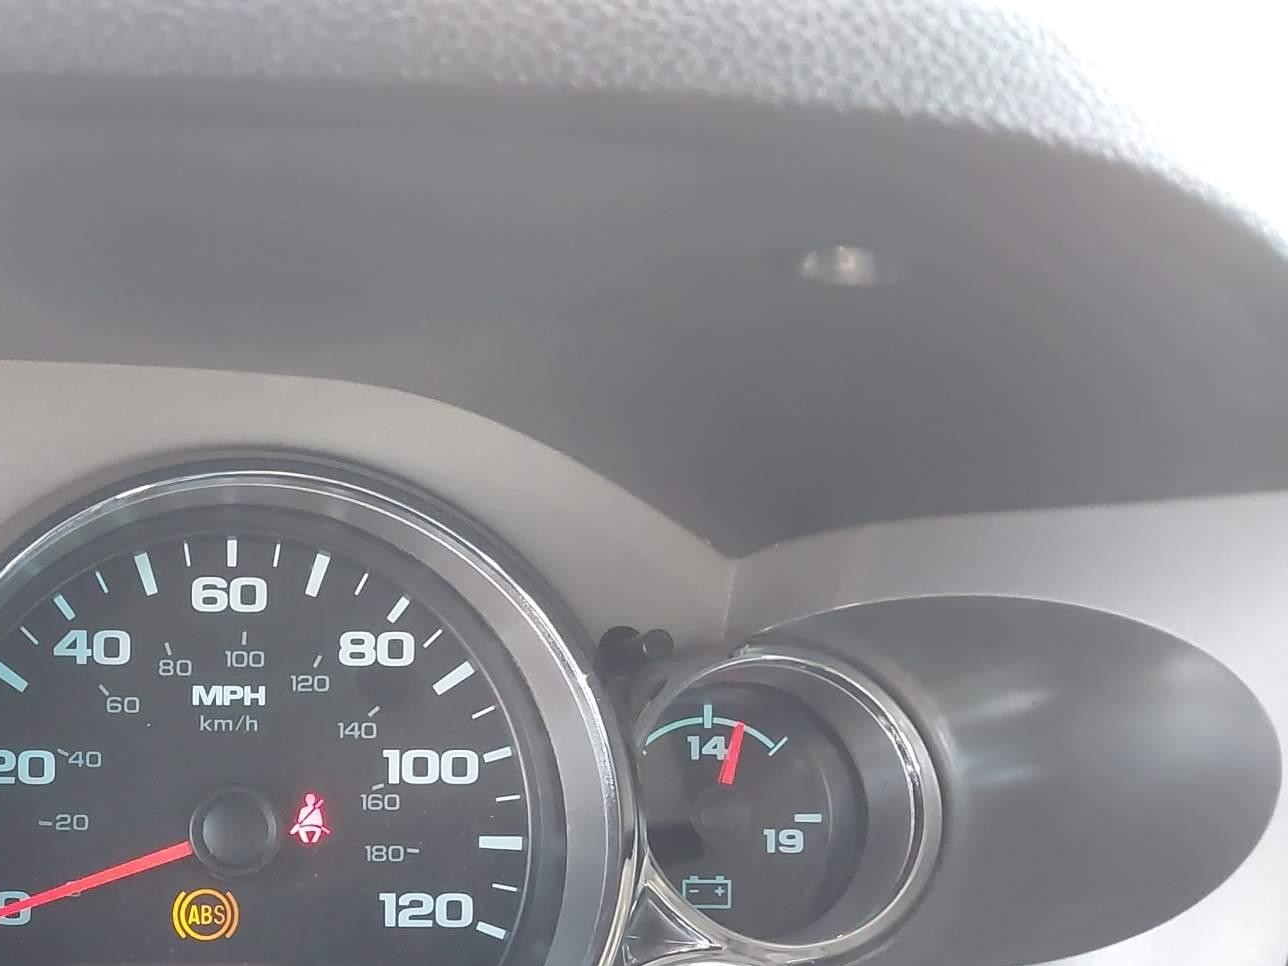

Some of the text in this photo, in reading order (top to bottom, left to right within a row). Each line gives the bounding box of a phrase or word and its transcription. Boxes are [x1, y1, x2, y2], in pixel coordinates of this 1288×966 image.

[191, 576, 268, 613] 60
[53, 629, 131, 666] 40
[338, 631, 415, 667] 80
[158, 659, 193, 677] 80
[224, 650, 265, 668] 100
[290, 675, 330, 692] 120
[192, 685, 266, 706] MPH
[106, 696, 140, 714] 60
[199, 714, 259, 732] km/h
[337, 722, 378, 739] 140
[687, 735, 729, 761] 14
[67, 751, 102, 768] 40
[382, 749, 479, 786] 100
[360, 793, 401, 811] 160
[55, 814, 89, 831] 20
[763, 828, 805, 854] 19
[364, 845, 405, 862] 180
[188, 904, 226, 925] ABS
[379, 892, 474, 928] 120
